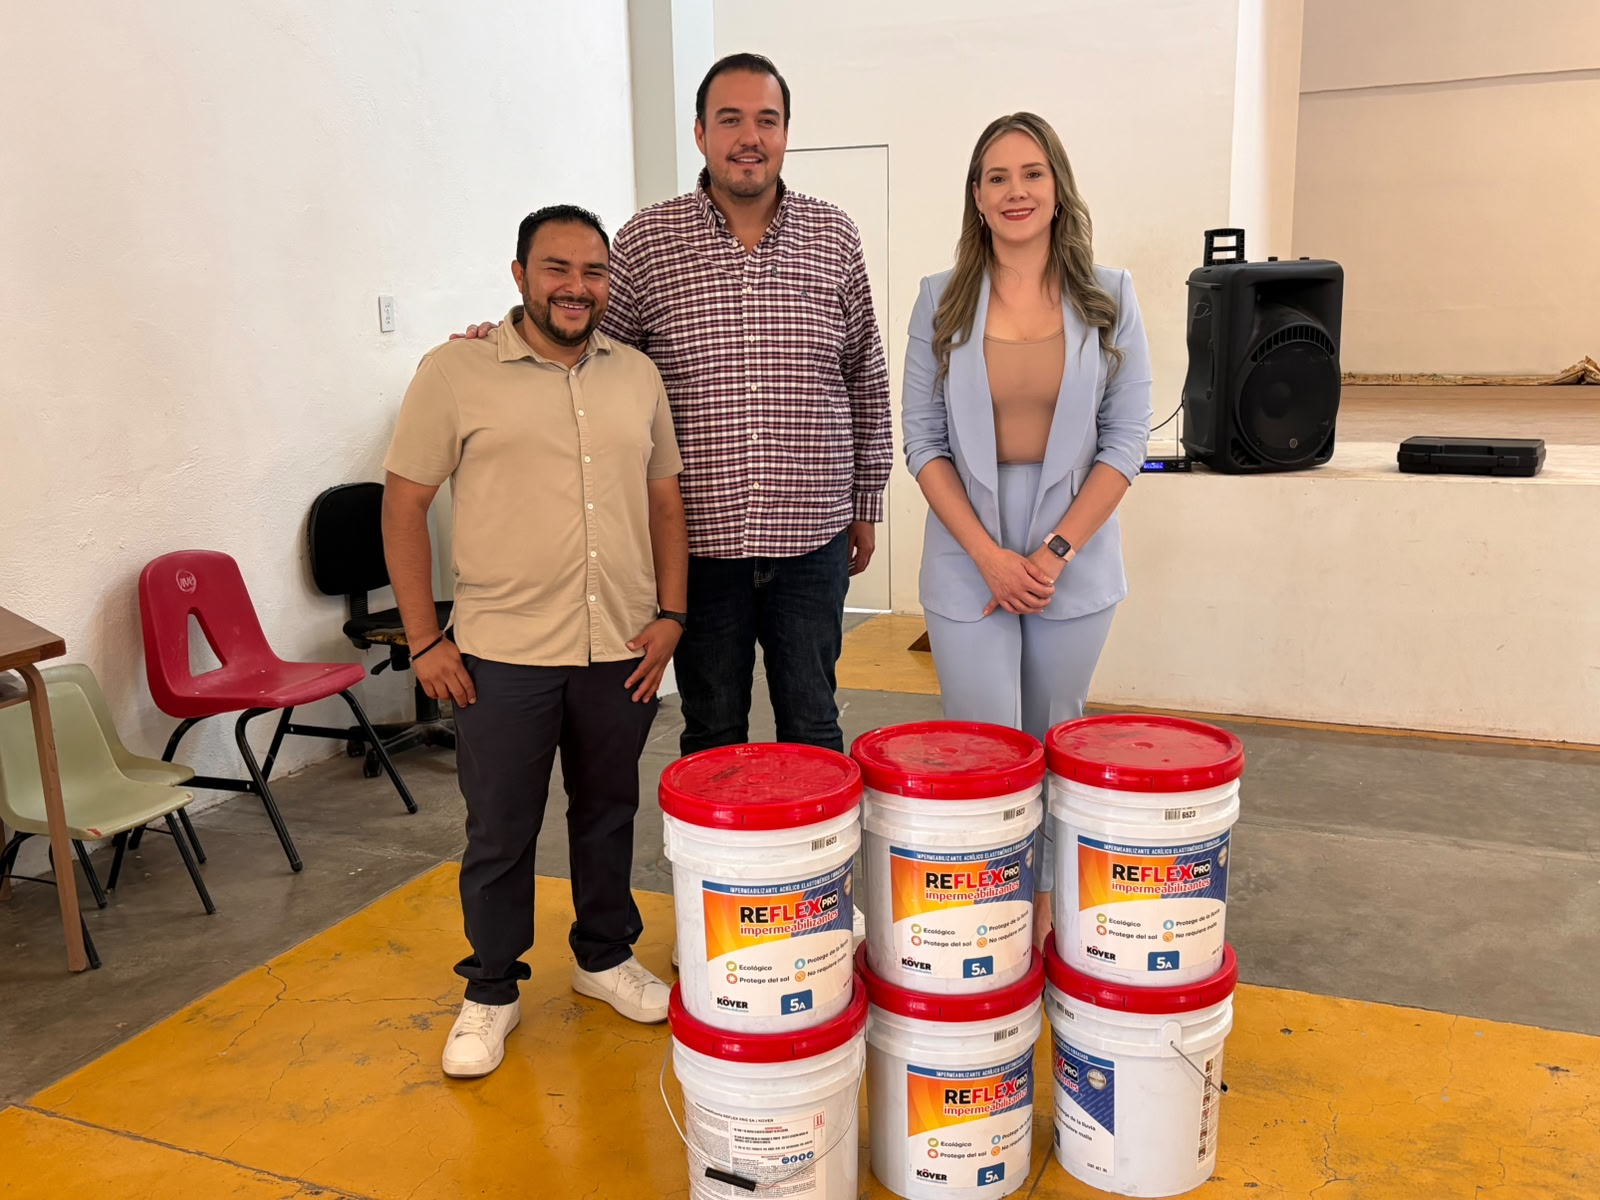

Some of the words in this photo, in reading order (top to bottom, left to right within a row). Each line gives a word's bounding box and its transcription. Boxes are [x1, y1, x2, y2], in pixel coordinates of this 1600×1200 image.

[1104, 844, 1150, 854] IMPERMEABILIZANTE
[917, 853, 962, 861] IMPERMEABILIZANTE
[925, 867, 1004, 889] REFLEX
[1004, 866, 1019, 878] PRO
[1113, 864, 1194, 883] REFLEX
[1194, 863, 1210, 875] PRO
[730, 886, 778, 894] IMPERMEABILIZANTE
[926, 880, 1019, 902] impermeabilizantes
[1112, 878, 1210, 894] impermeabilizantes
[740, 896, 821, 923] REFLEX
[822, 894, 838, 909] PRO
[740, 910, 838, 936] impermeabilizantes
[989, 922, 1009, 931] Protege
[1109, 918, 1141, 927] Ecológico
[1109, 930, 1134, 939] Protege
[808, 953, 828, 964] Protege
[1156, 957, 1172, 969] 5A
[739, 964, 772, 972] Ecológico
[971, 963, 986, 975] 5A
[790, 998, 805, 1012] 5A
[1064, 1063, 1078, 1077] PRO
[945, 1079, 1016, 1104] REFLEX
[1016, 1073, 1027, 1088] PRO
[944, 1088, 1027, 1116] impermeabilizantes
[985, 1171, 998, 1182] 5A
